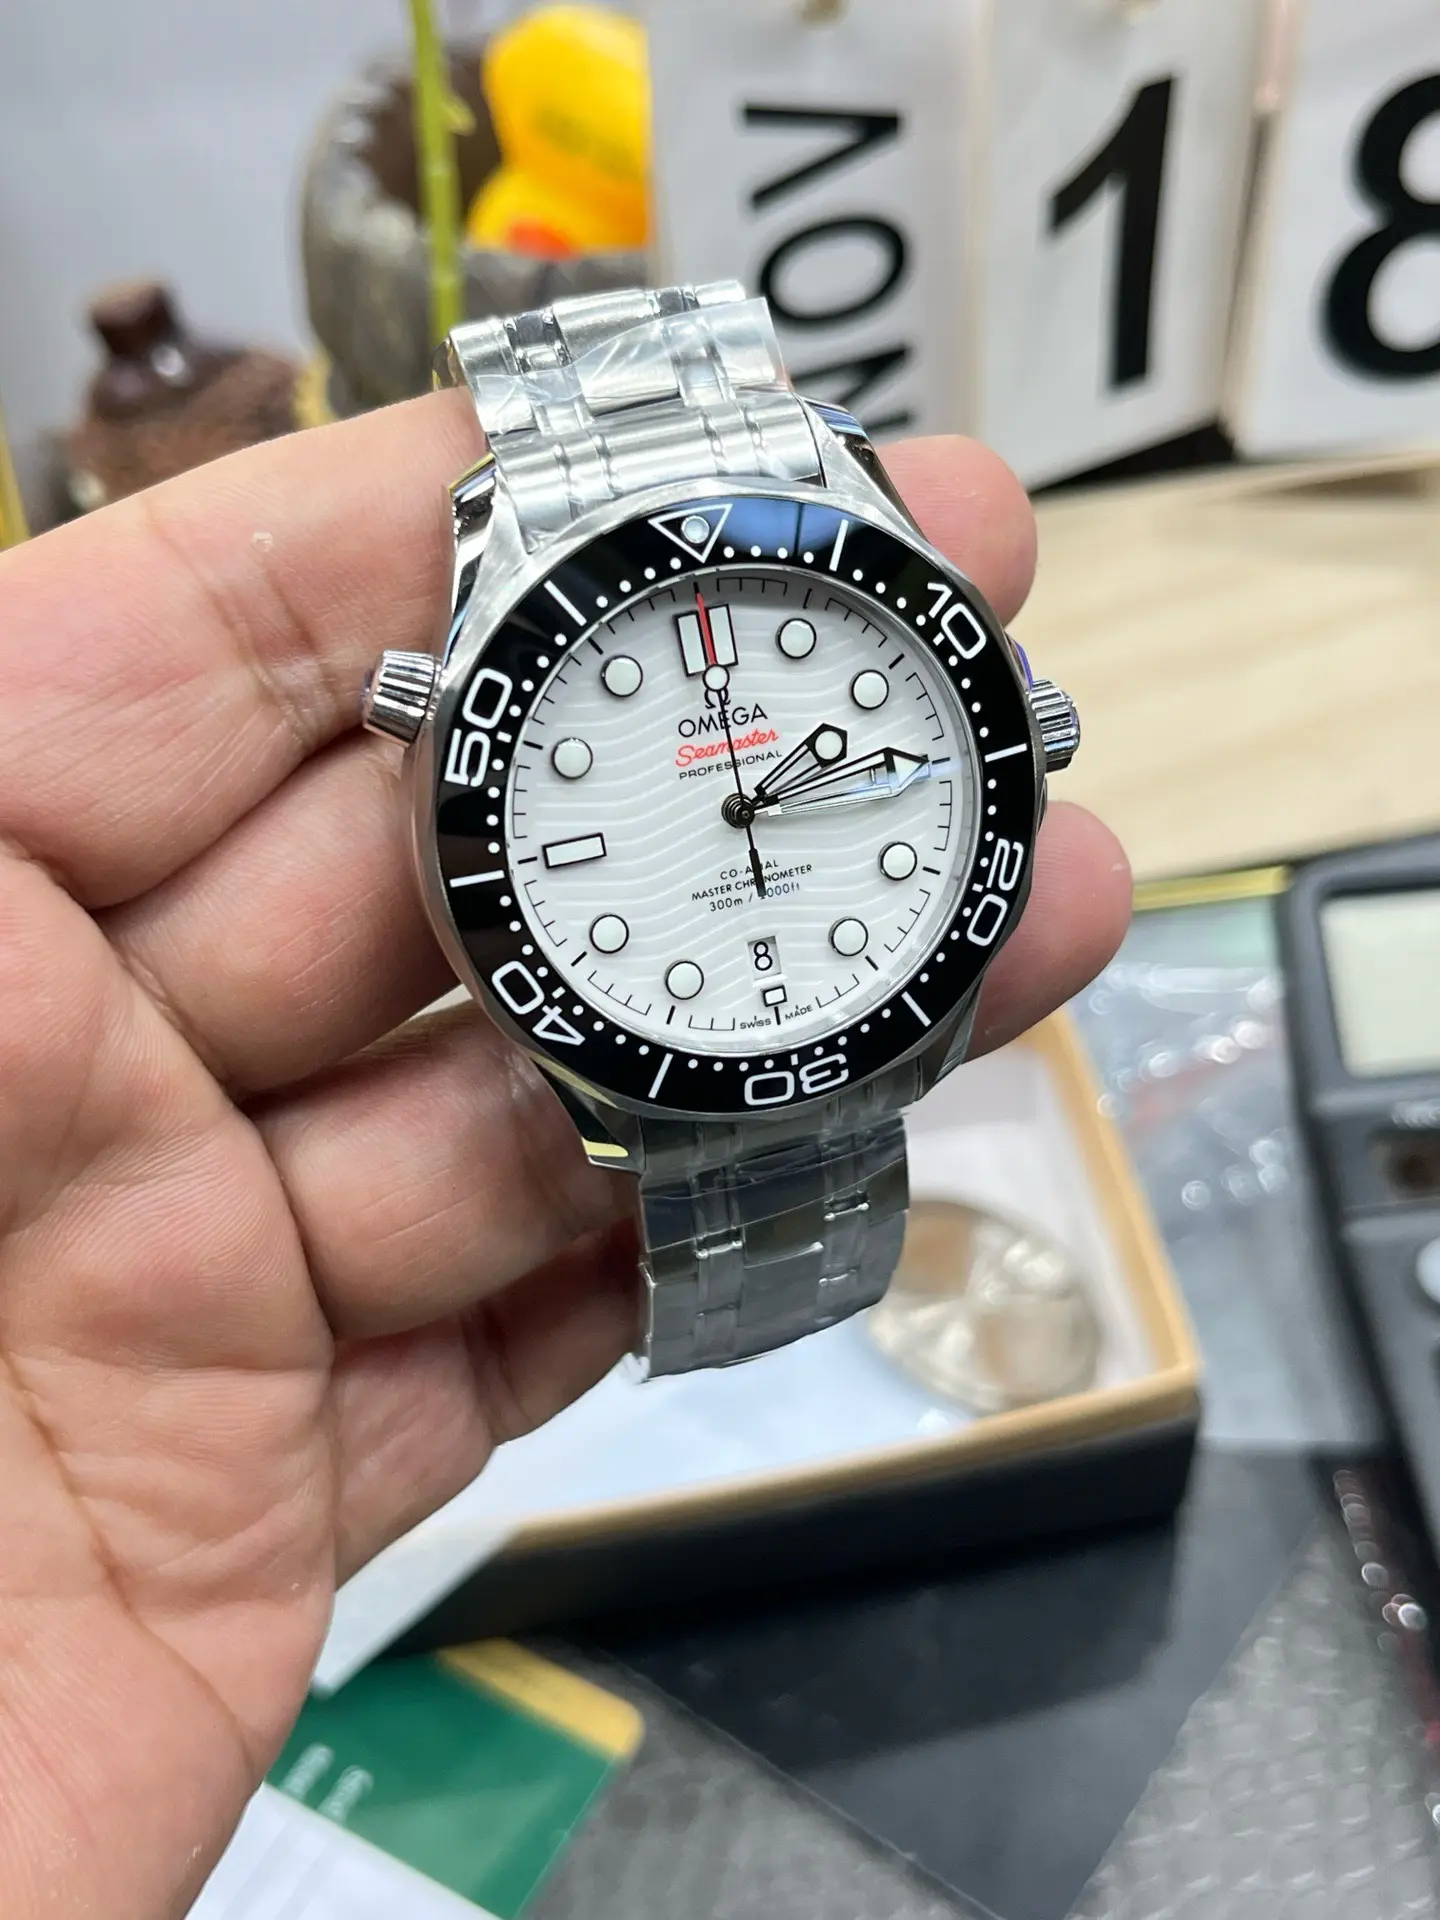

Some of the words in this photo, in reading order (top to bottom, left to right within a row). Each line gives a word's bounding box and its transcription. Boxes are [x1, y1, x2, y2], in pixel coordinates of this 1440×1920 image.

[927, 582, 987, 660] 10
[444, 667, 513, 788] 50
[677, 703, 768, 738] OMEGA
[675, 727, 779, 767] Seamaster
[679, 750, 783, 780] PROFESSIONAL
[691, 883, 732, 901] MASTER
[735, 864, 812, 890] CHRNOMETER
[720, 859, 779, 880] CO-AIAL
[709, 896, 743, 912] 300m
[966, 838, 1024, 947] 20
[753, 940, 773, 971] 8
[492, 960, 585, 1046] 40
[739, 1018, 772, 1030] SWISS
[785, 1005, 813, 1020] MADE
[744, 1053, 849, 1106] 30
